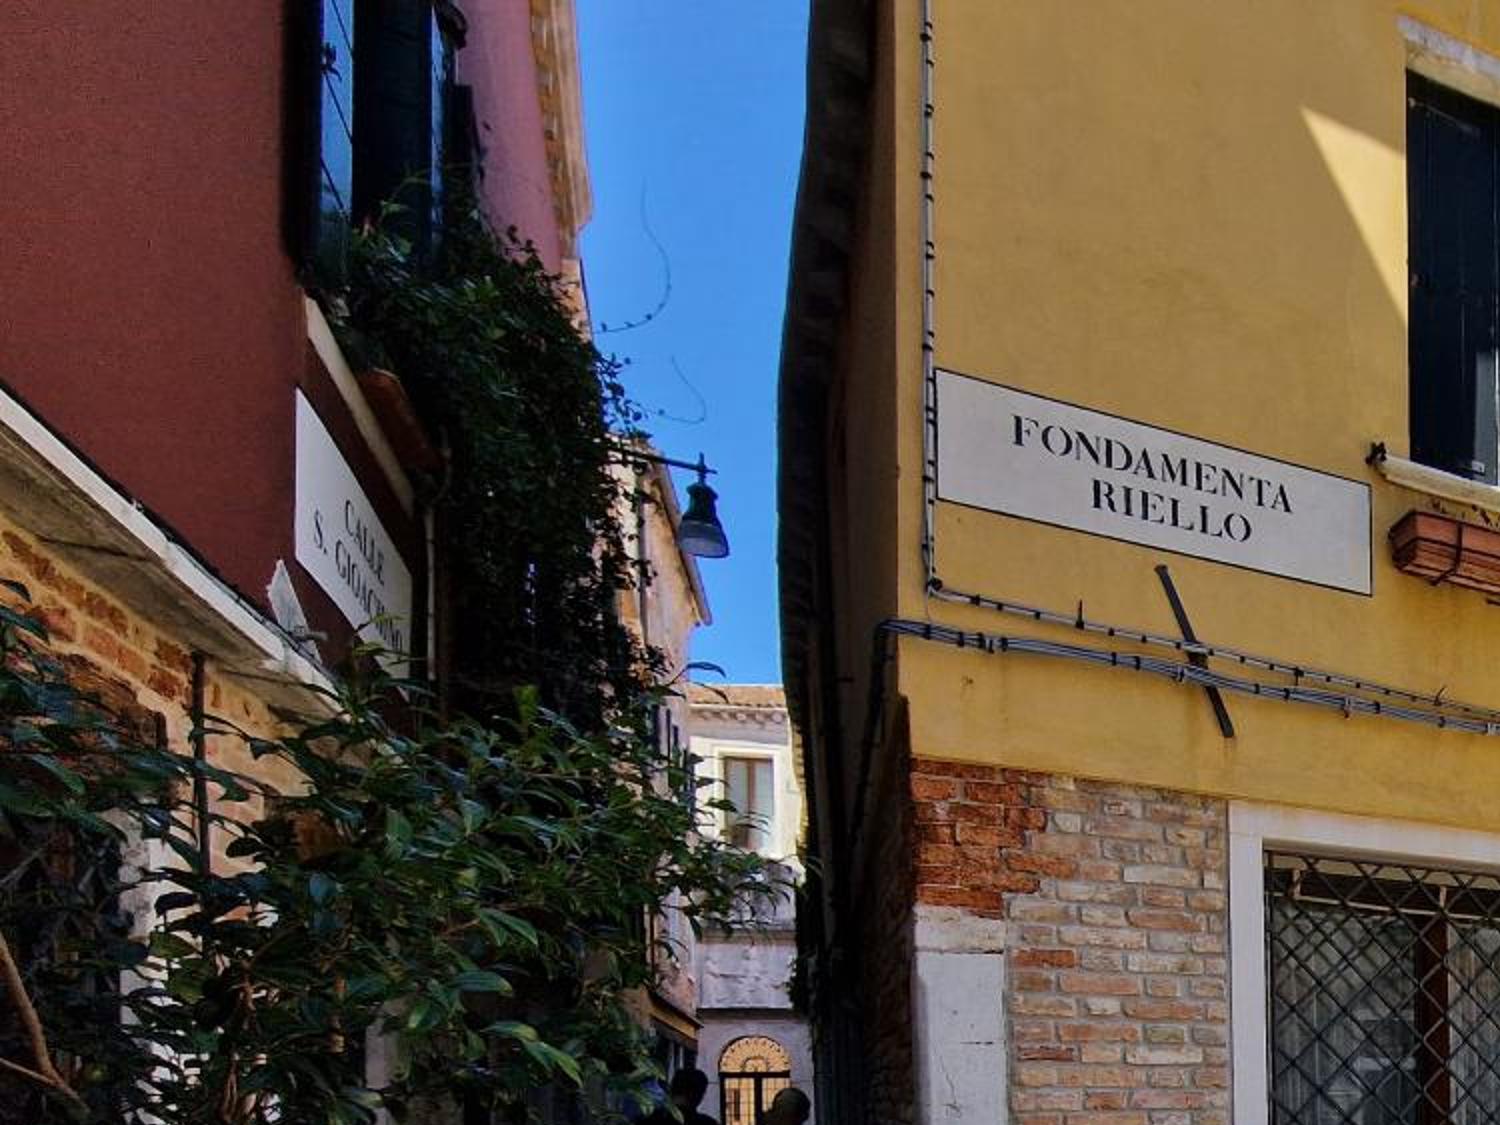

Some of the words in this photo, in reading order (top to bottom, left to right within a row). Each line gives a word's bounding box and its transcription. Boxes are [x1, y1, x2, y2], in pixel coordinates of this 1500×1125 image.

[1013, 415, 1294, 513] FONDAMENTA
[313, 508, 328, 554] S.
[345, 500, 385, 585] CALLE
[1092, 479, 1253, 543] RIELLO
